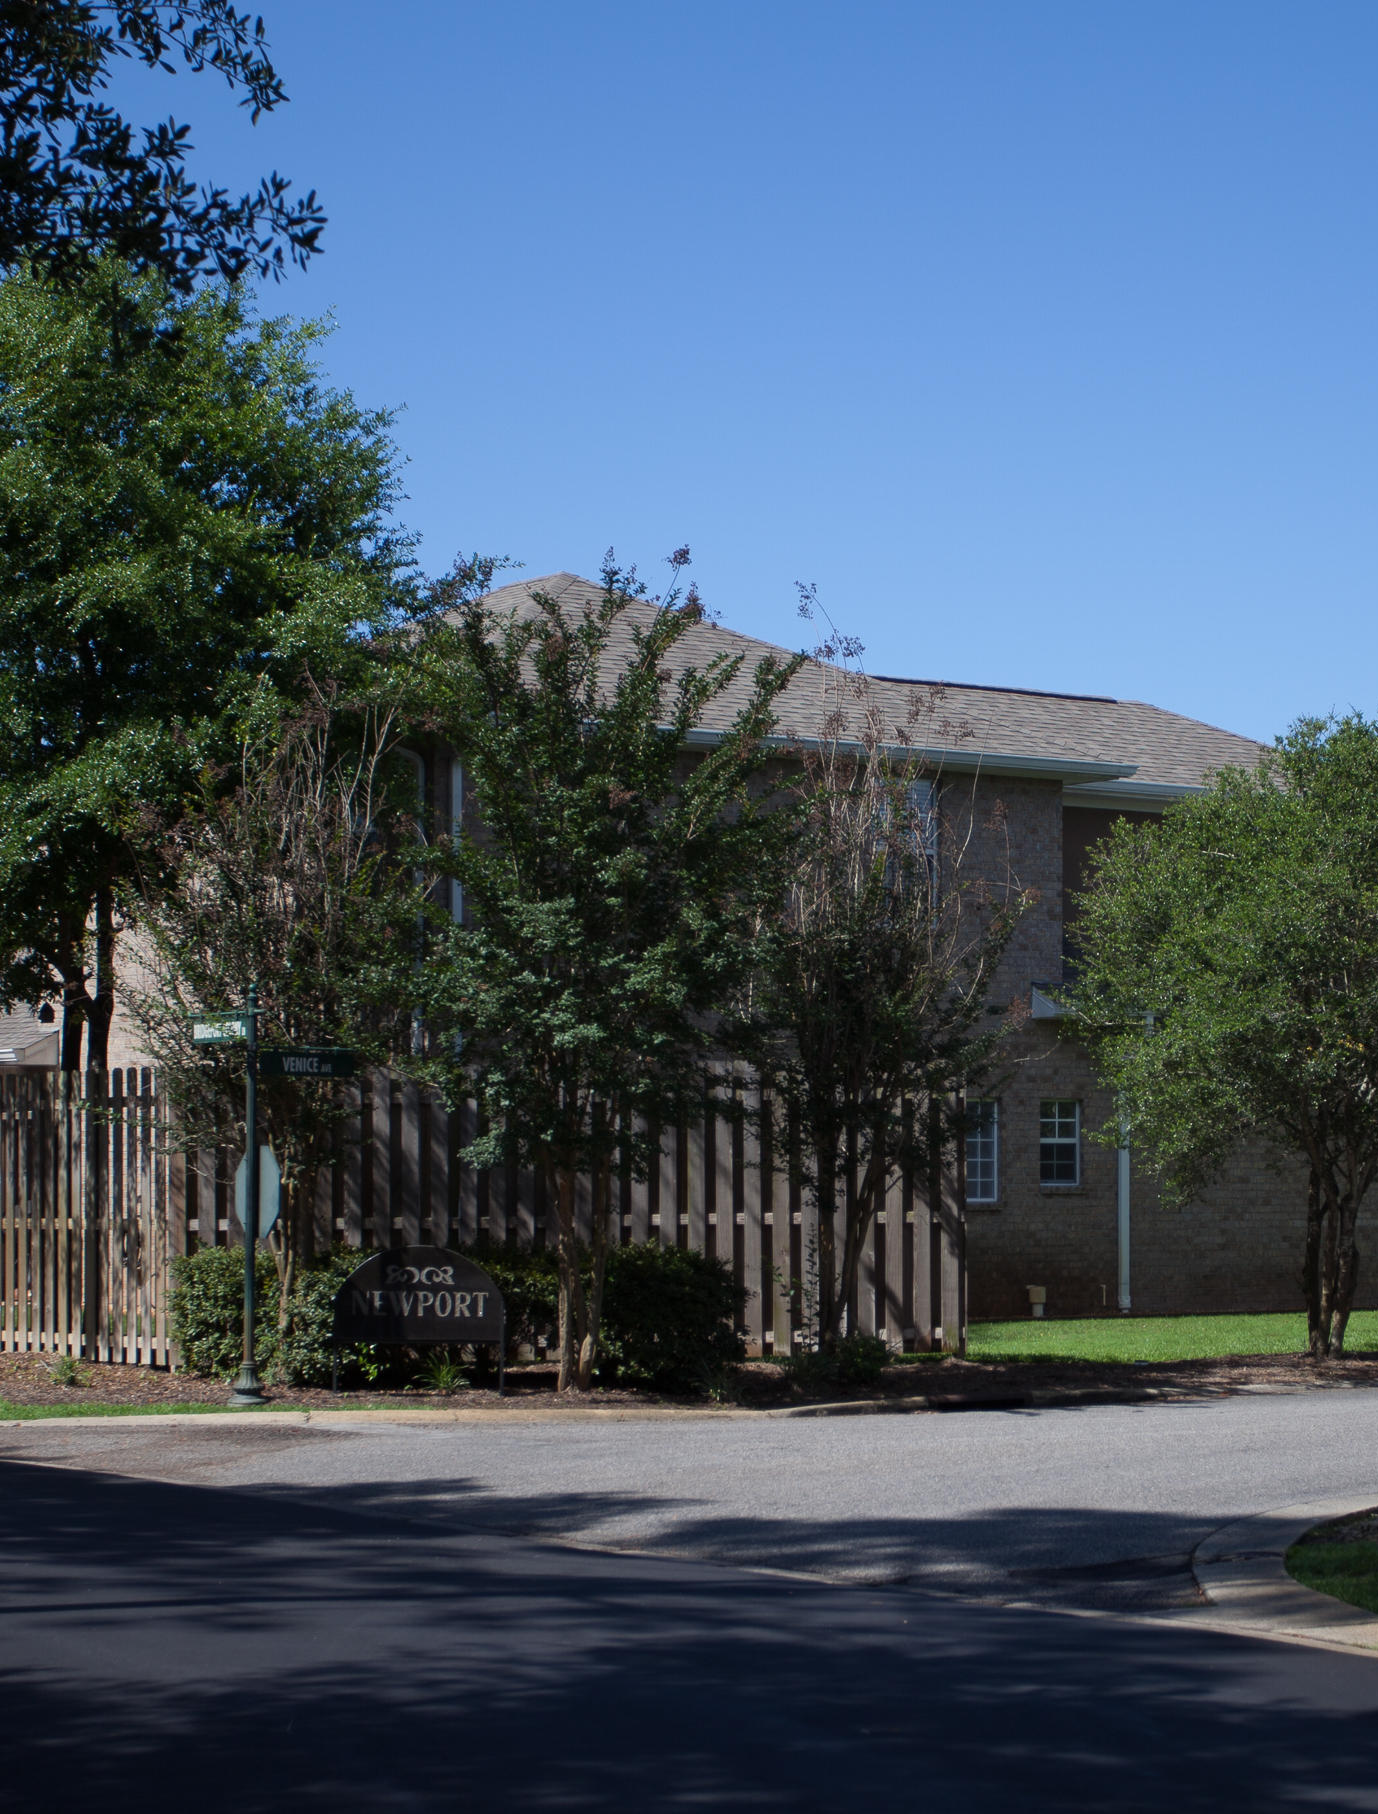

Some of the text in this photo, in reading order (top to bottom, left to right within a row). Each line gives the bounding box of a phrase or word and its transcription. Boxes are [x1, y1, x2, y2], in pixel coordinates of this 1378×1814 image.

[282, 1056, 332, 1073] VENICE AVE
[352, 1290, 488, 1318] NEWPORT
